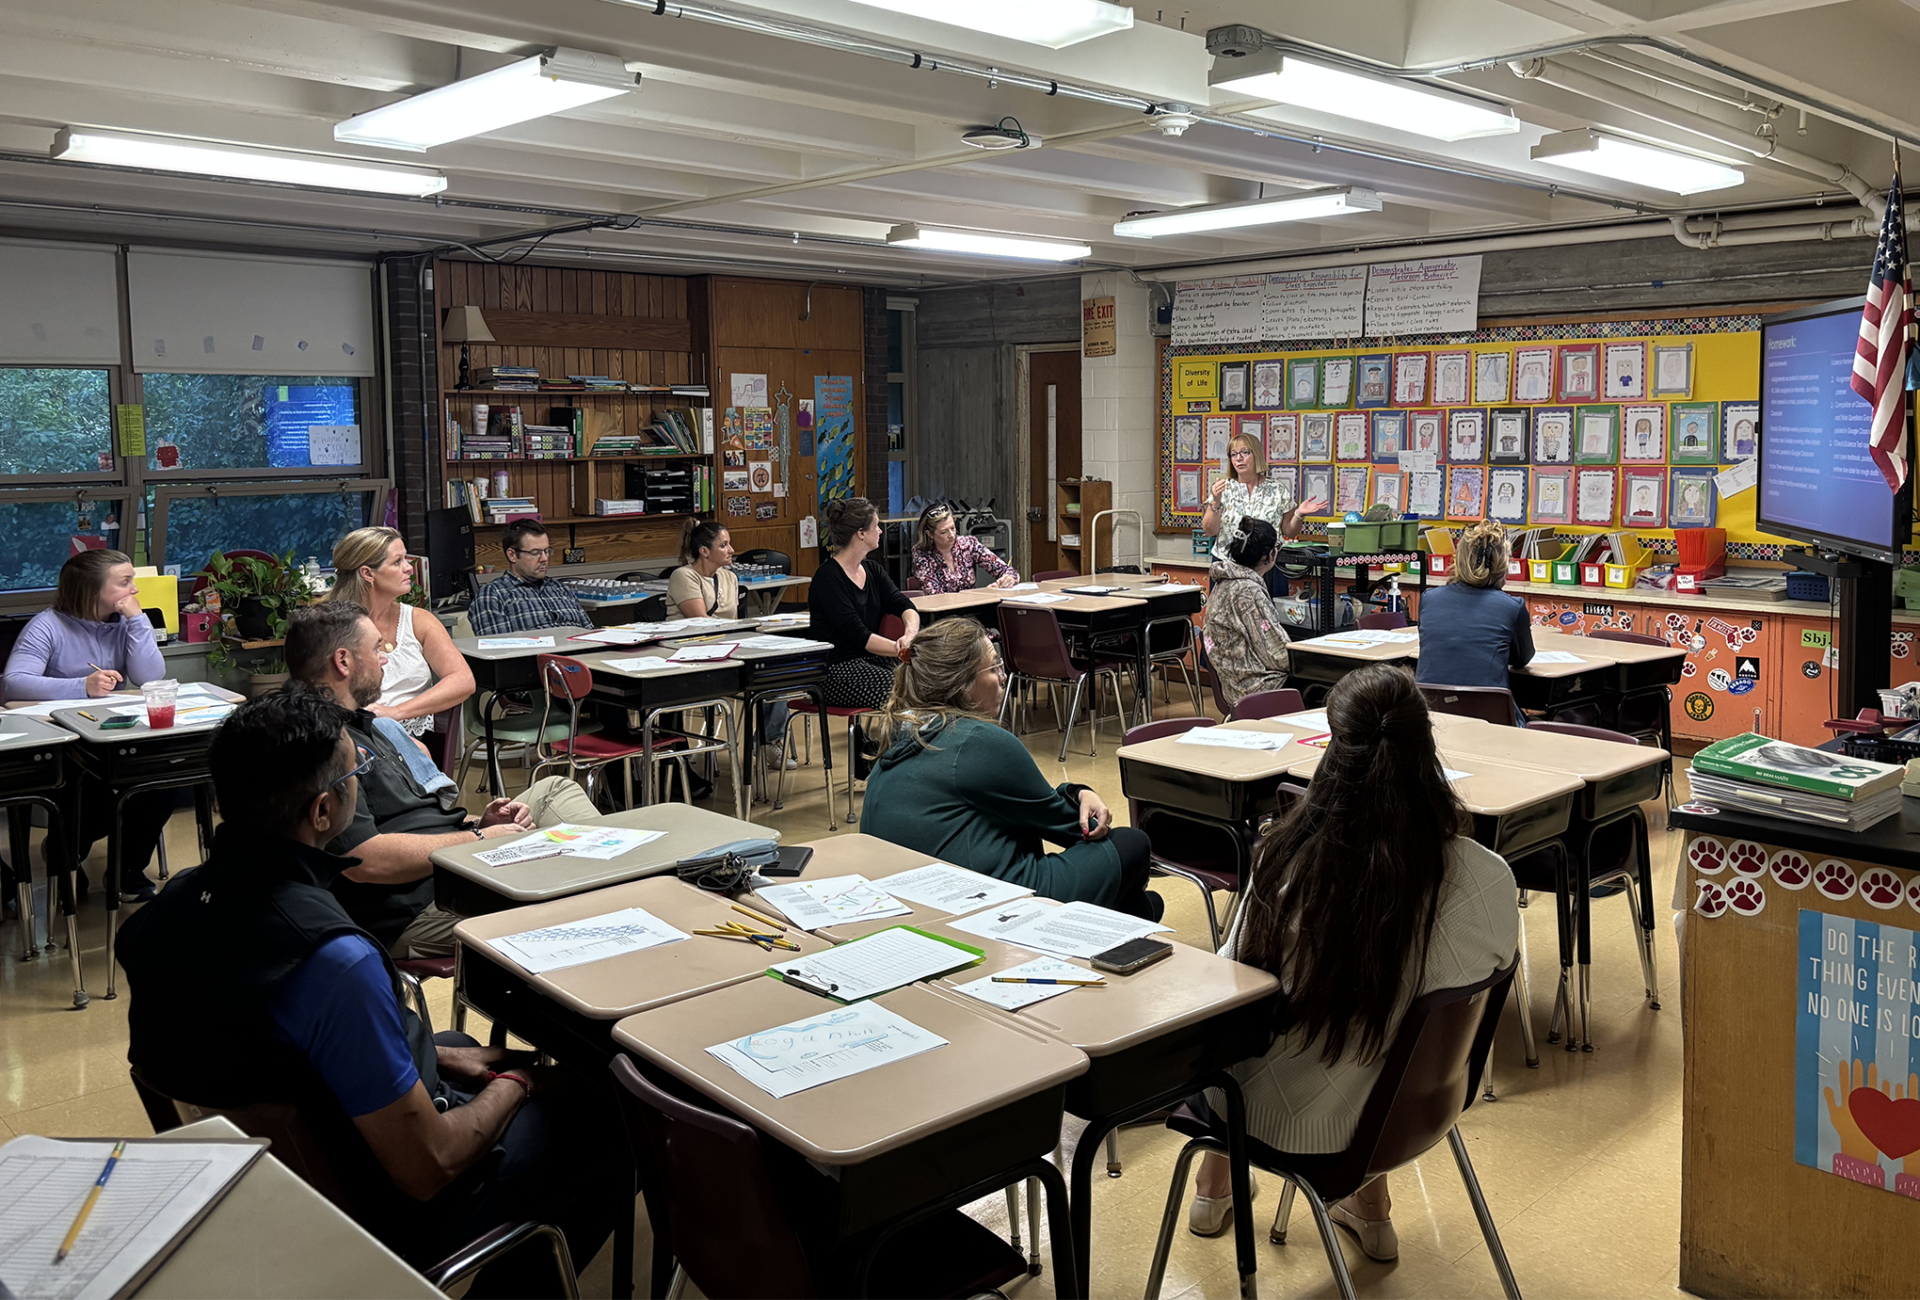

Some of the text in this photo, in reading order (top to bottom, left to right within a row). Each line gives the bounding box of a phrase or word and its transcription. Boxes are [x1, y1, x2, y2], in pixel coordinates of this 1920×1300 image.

[1351, 268, 1362, 278] for
[1372, 264, 1413, 275] Demonstrates
[1390, 273, 1420, 281] Classroom
[1097, 305, 1114, 319] EXIT
[1185, 369, 1211, 377] Diversity
[1186, 379, 1208, 387] of Life
[331, 442, 347, 451] YOU
[1709, 620, 1732, 635] FAMILY
[1891, 631, 1914, 642] ope
[1729, 679, 1752, 690] SEBAGO
[1827, 928, 1920, 969] DO THE R
[1809, 957, 1920, 1005] THING EVEN
[1808, 991, 1830, 1019] NO
[1837, 998, 1870, 1027] ONE
[1877, 1008, 1893, 1033] IS
